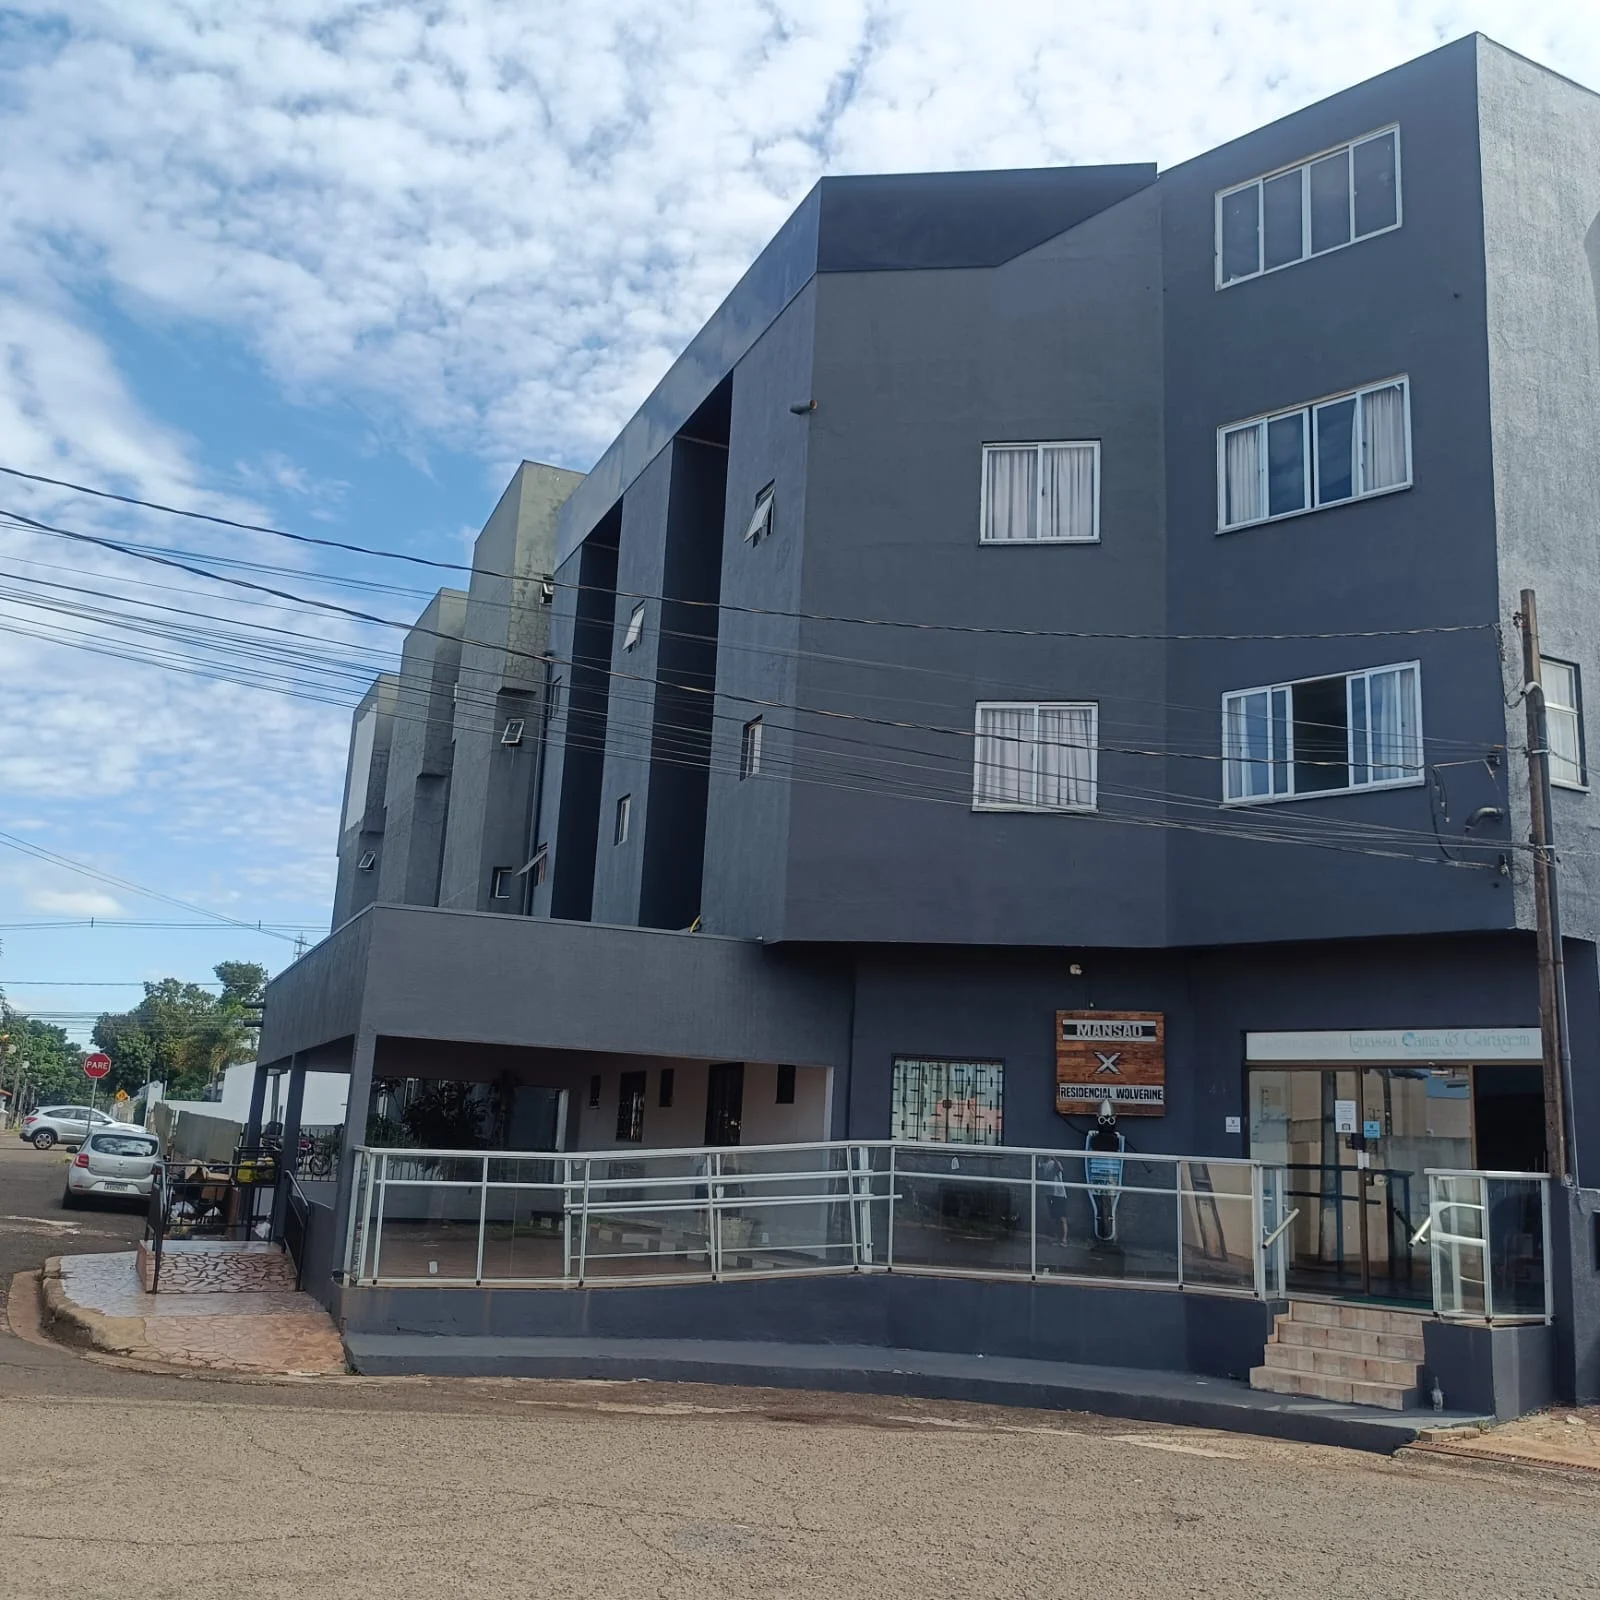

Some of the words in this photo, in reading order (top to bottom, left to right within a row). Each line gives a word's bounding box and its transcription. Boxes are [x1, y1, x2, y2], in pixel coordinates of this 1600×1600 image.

[86, 1061, 109, 1070] PARE
[1092, 1051, 1121, 1075] X
[1060, 1086, 1112, 1099] RESIDENCIAL
[1116, 1088, 1162, 1100] WOLVERINE
